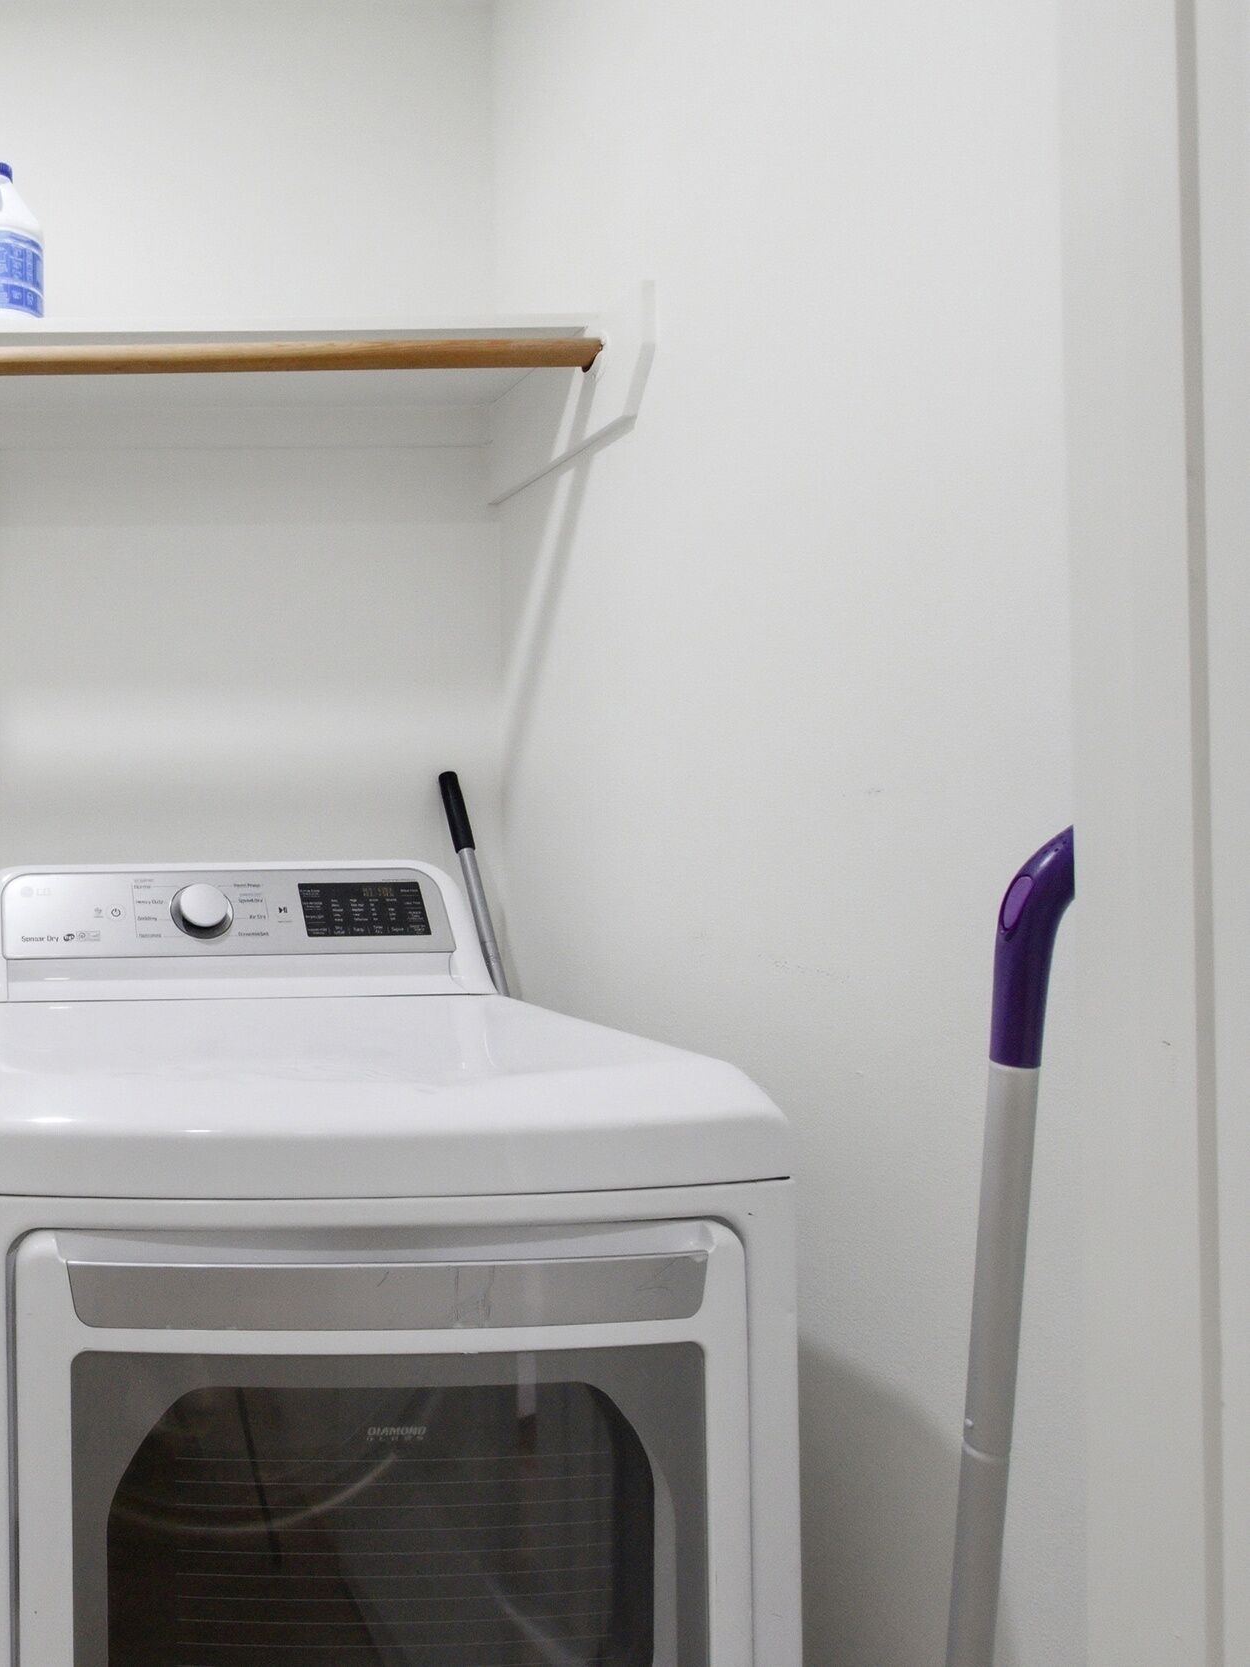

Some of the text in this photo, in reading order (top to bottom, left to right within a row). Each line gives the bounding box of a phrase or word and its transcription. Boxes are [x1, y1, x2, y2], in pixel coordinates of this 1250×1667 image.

[21, 935, 59, 943] Sensor Dry
[366, 1426, 427, 1436] DIAMOND
